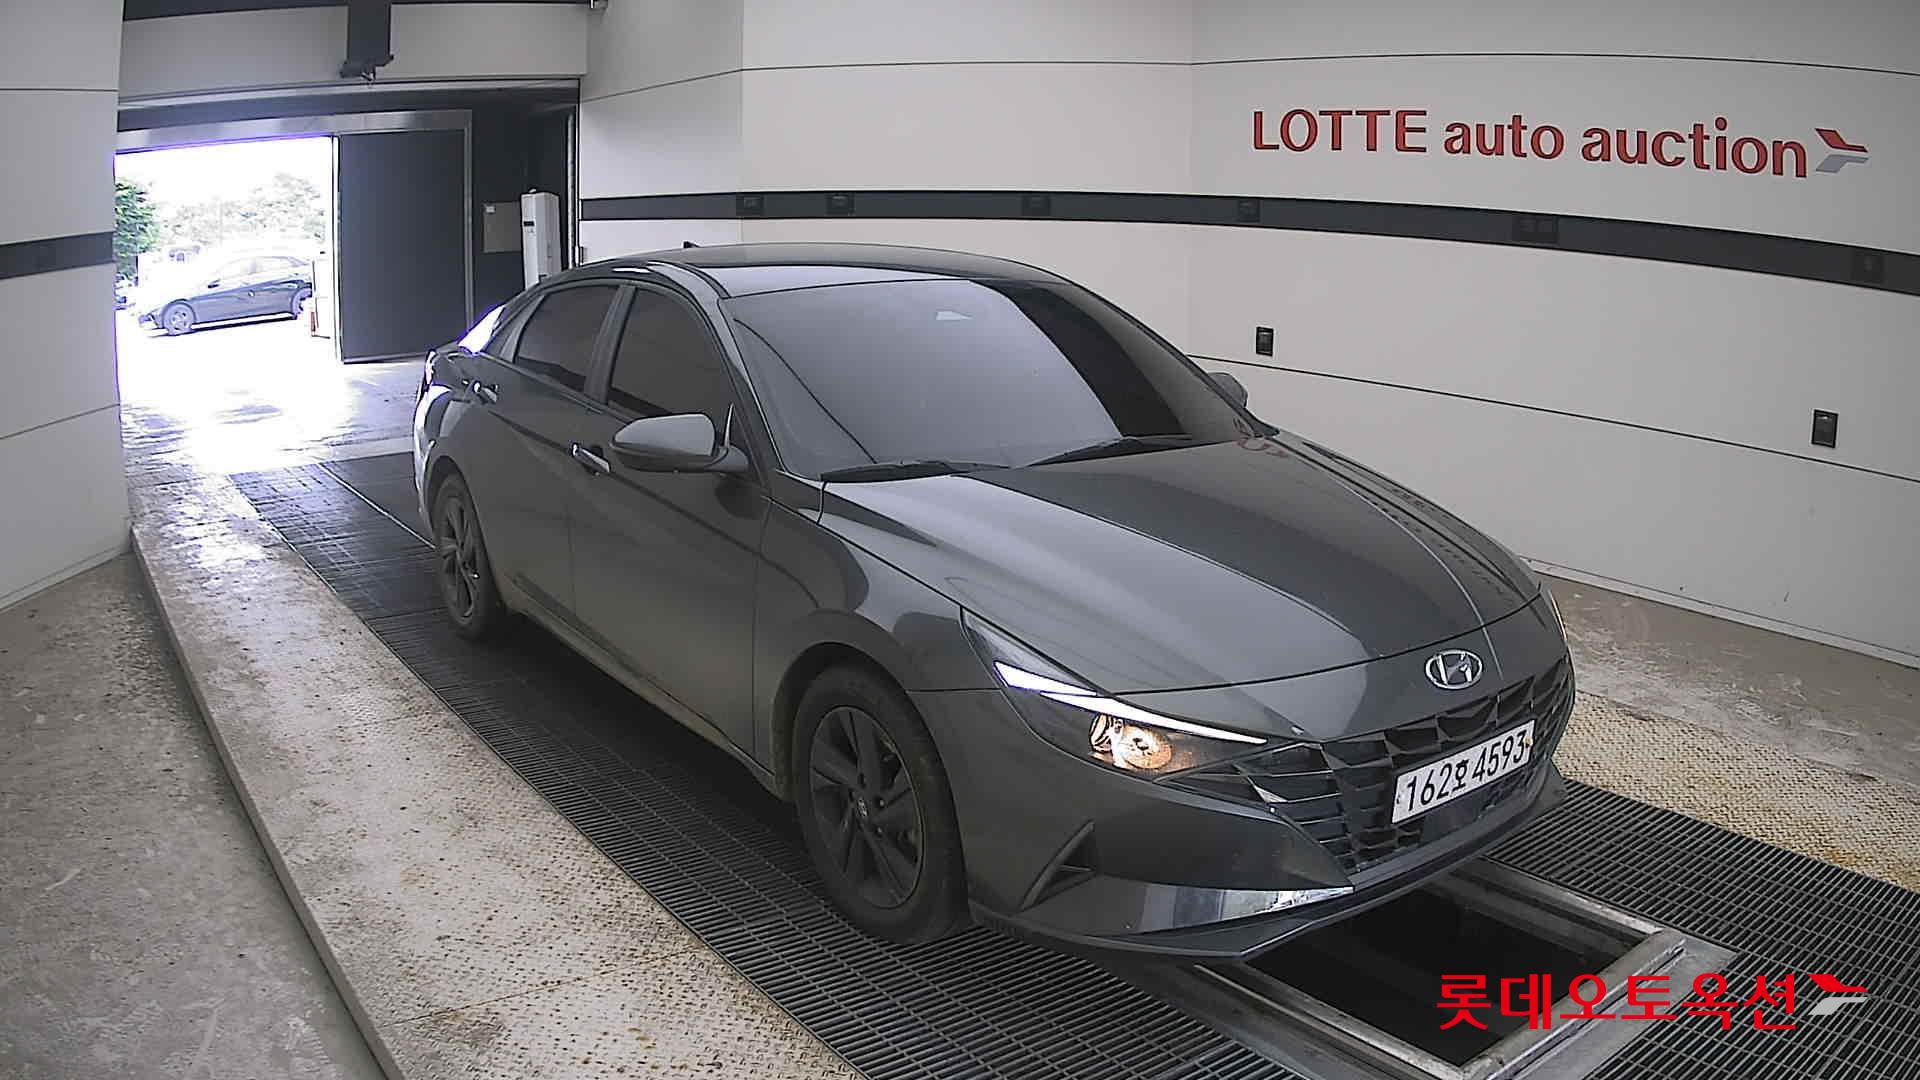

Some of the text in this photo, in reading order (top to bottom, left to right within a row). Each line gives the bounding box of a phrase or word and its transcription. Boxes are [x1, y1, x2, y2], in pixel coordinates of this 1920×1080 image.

[1252, 109, 1809, 179] LOTTE auto auction
